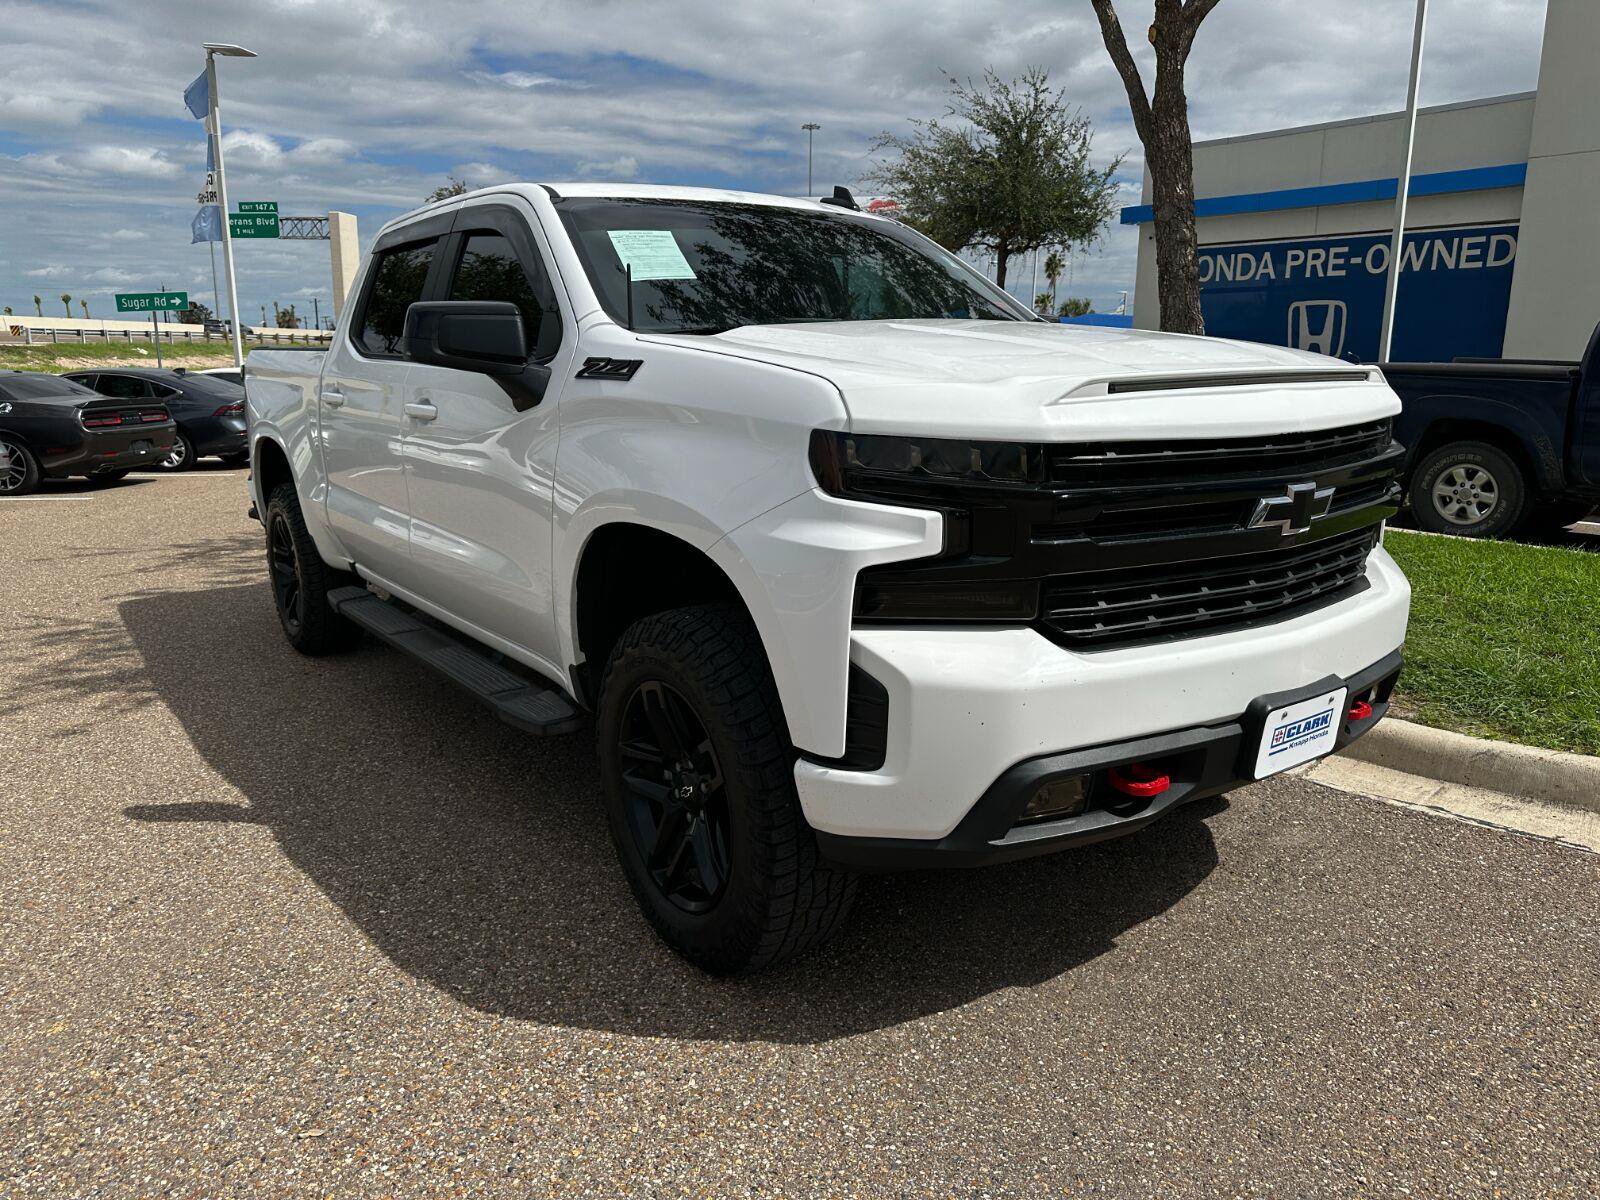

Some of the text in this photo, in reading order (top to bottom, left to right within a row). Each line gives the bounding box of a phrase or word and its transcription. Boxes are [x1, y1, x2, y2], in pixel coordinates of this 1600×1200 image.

[229, 217, 275, 226] erans Blvd
[1199, 233, 1517, 283] ONDA PRE-OWNED
[121, 296, 167, 310] Sugar Rd
[574, 356, 645, 382] Z71
[1286, 714, 1329, 738] CLARK
[1289, 730, 1329, 749] Knapp Honda
